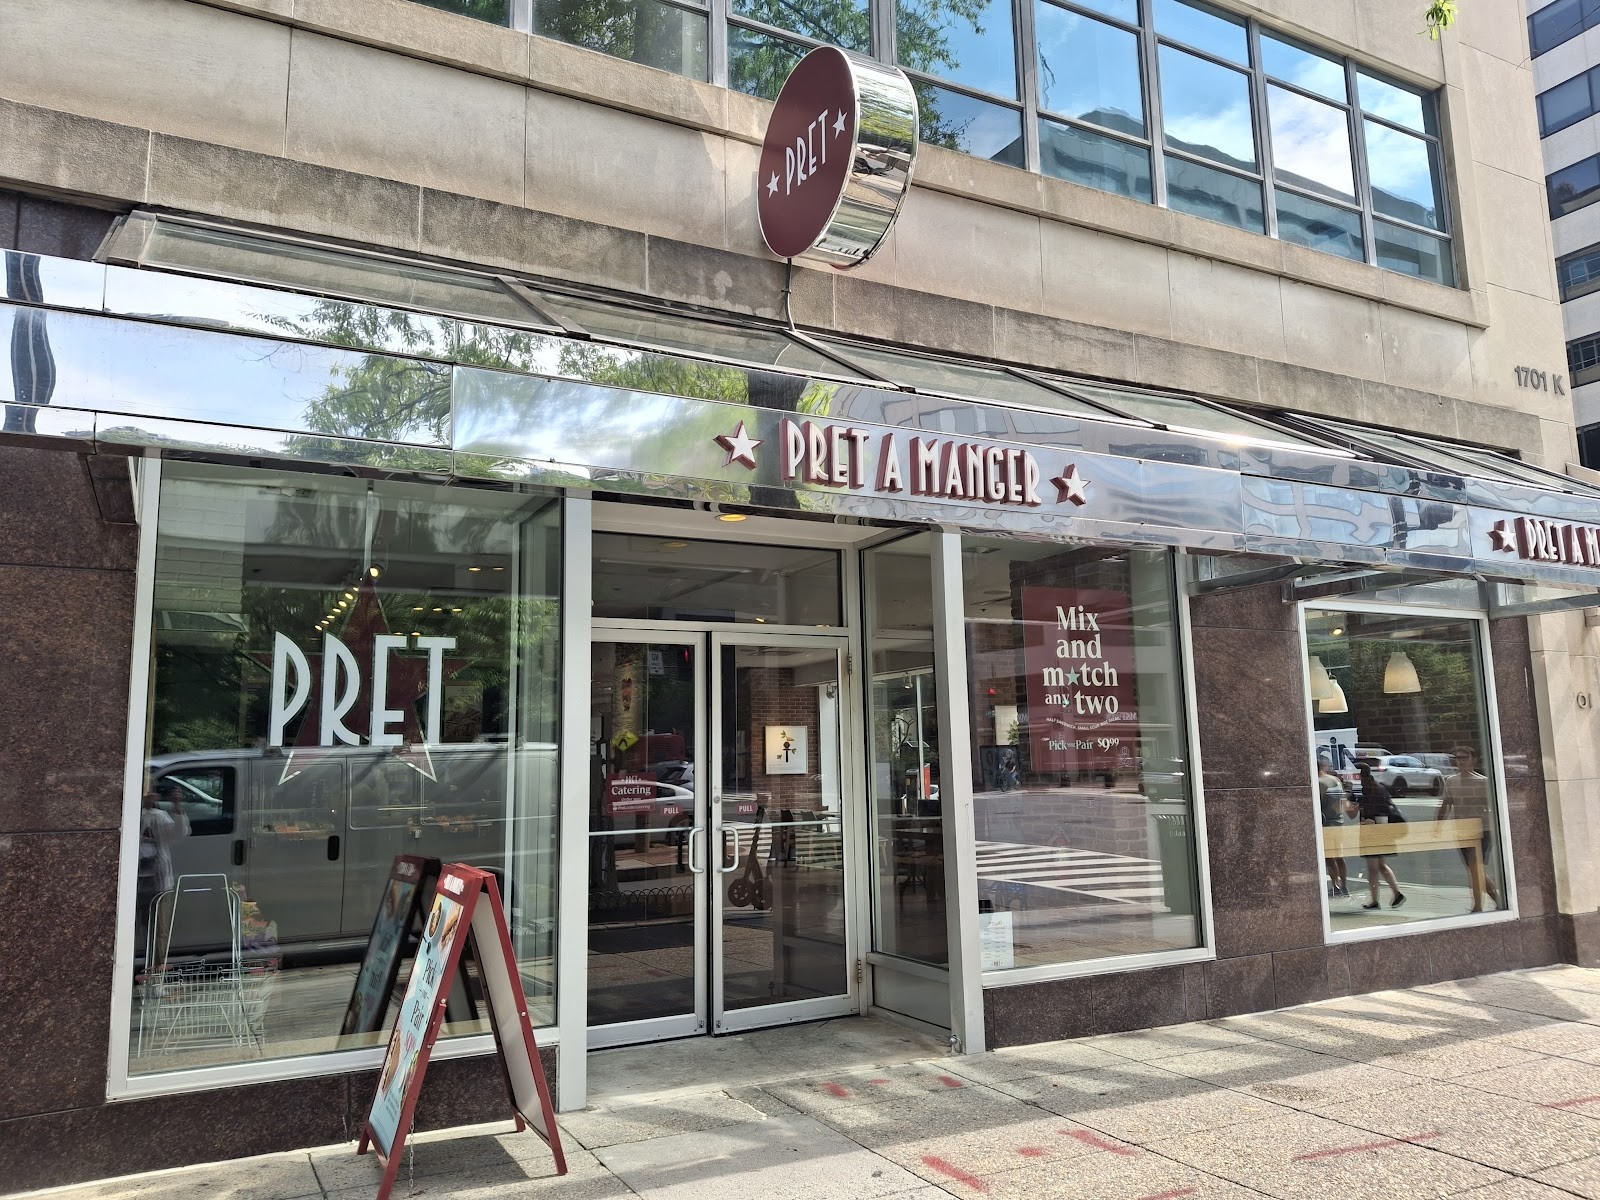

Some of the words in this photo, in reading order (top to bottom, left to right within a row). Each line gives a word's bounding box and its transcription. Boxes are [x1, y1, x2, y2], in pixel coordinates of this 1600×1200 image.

[785, 109, 829, 196] PRET
[1513, 365, 1548, 392] 1701
[1552, 373, 1566, 396] K
[779, 417, 870, 489] PRET
[874, 432, 904, 493] A
[909, 436, 1042, 507] MANGER
[1514, 516, 1567, 562] PRET
[1562, 524, 1585, 565] A
[1056, 605, 1100, 631] Mix
[1056, 633, 1103, 659] and
[1042, 661, 1119, 687] mtch
[269, 630, 457, 747] PRET
[1045, 693, 1070, 708] any
[1074, 690, 1119, 715] two
[1049, 739, 1067, 751] Pick
[1076, 739, 1093, 750] Pair
[611, 786, 651, 796] Catering
[663, 807, 680, 815] PULL
